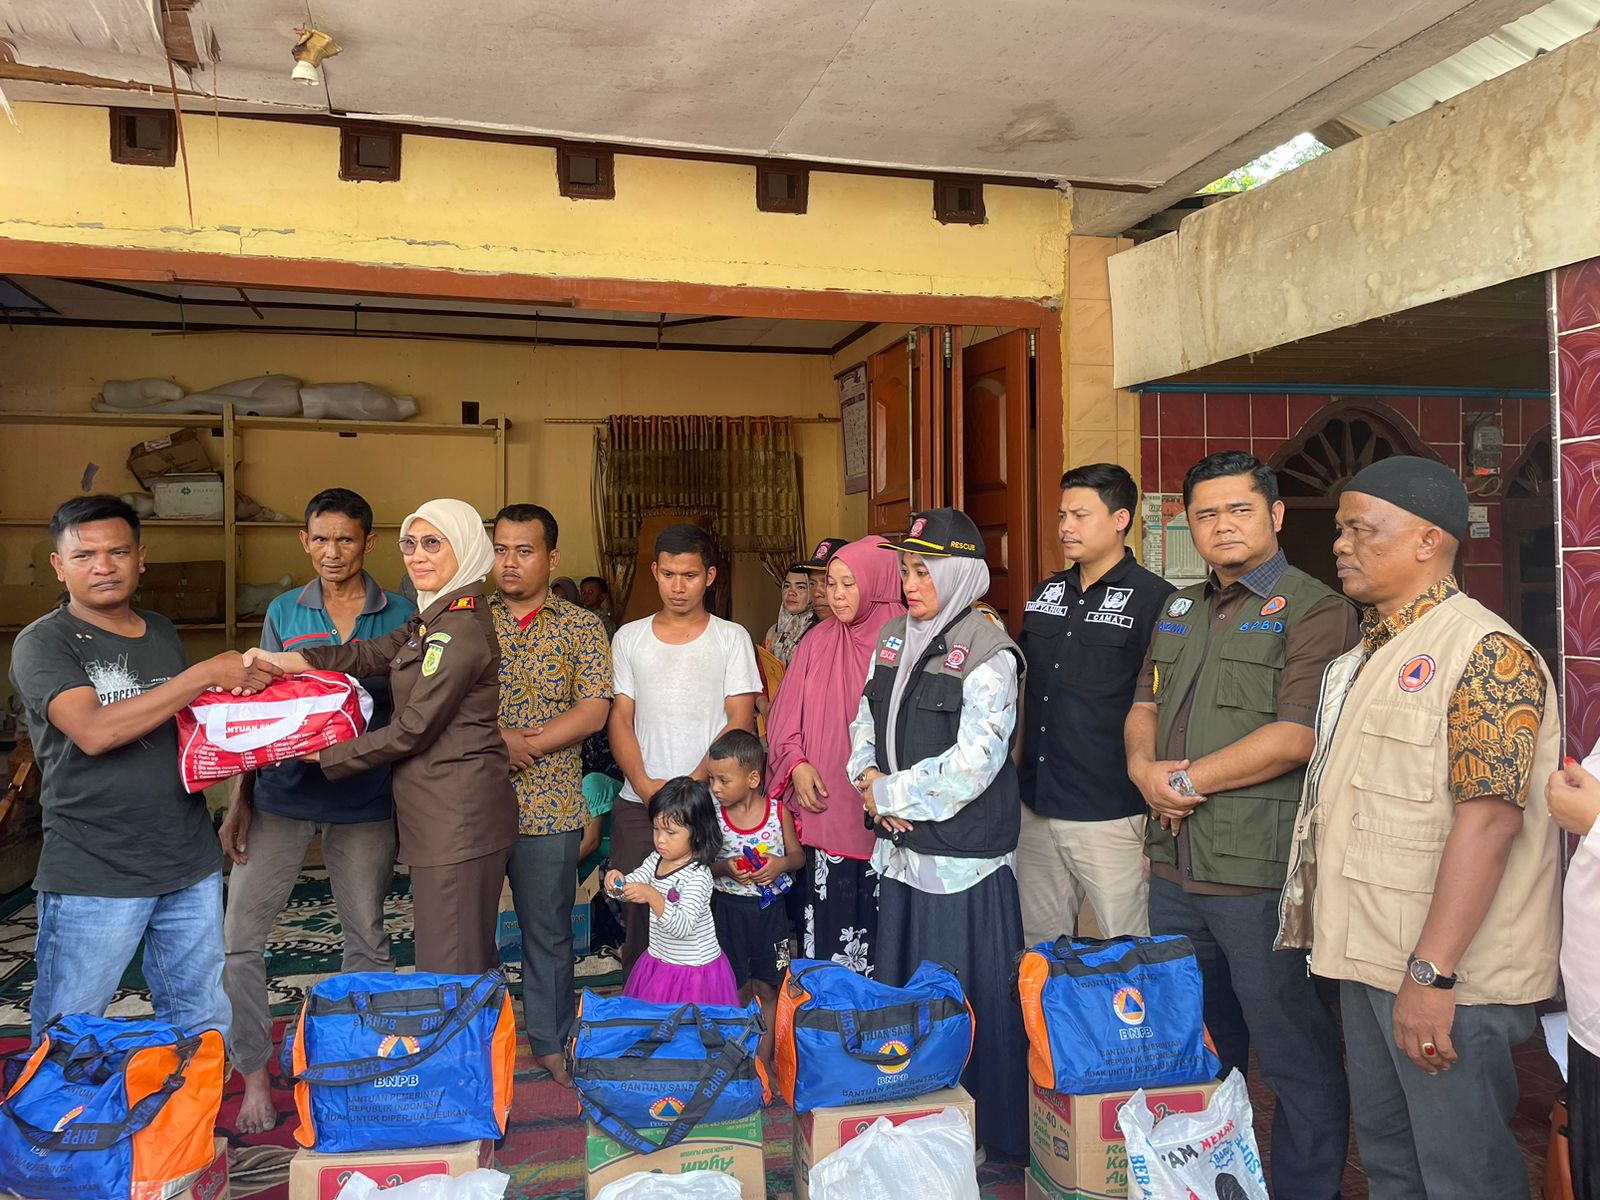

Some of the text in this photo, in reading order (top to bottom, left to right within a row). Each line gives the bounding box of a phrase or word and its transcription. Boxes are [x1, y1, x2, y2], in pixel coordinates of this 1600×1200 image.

[950, 540, 976, 552] RESCUE
[1093, 614, 1124, 625] CAMAT
[1158, 621, 1188, 635] AZMI
[1239, 620, 1285, 633] BPBD
[366, 1013, 445, 1031] BNPB BNP
[860, 1029, 890, 1042] NTUAN
[1120, 1026, 1154, 1040] BNPB
[374, 1074, 419, 1088] BNPB
[621, 1082, 696, 1092] BANTUAN SAND
[702, 1068, 727, 1099] BNPB
[390, 1089, 447, 1101] PEMERINTAH
[842, 1085, 884, 1097] BANTUAN
[348, 1101, 443, 1113] REPUBLIK INDONESIA
[350, 1113, 379, 1122] UNTUK
[381, 1109, 469, 1122] DIPERJUALBELIKAN
[1046, 1111, 1057, 1129] 40
[61, 1128, 98, 1145] BNPB
[1106, 1144, 1127, 1155] Ra
[680, 1155, 735, 1173] Ayam
[1106, 1156, 1128, 1169] Ka
[1105, 1171, 1128, 1187] Ay
